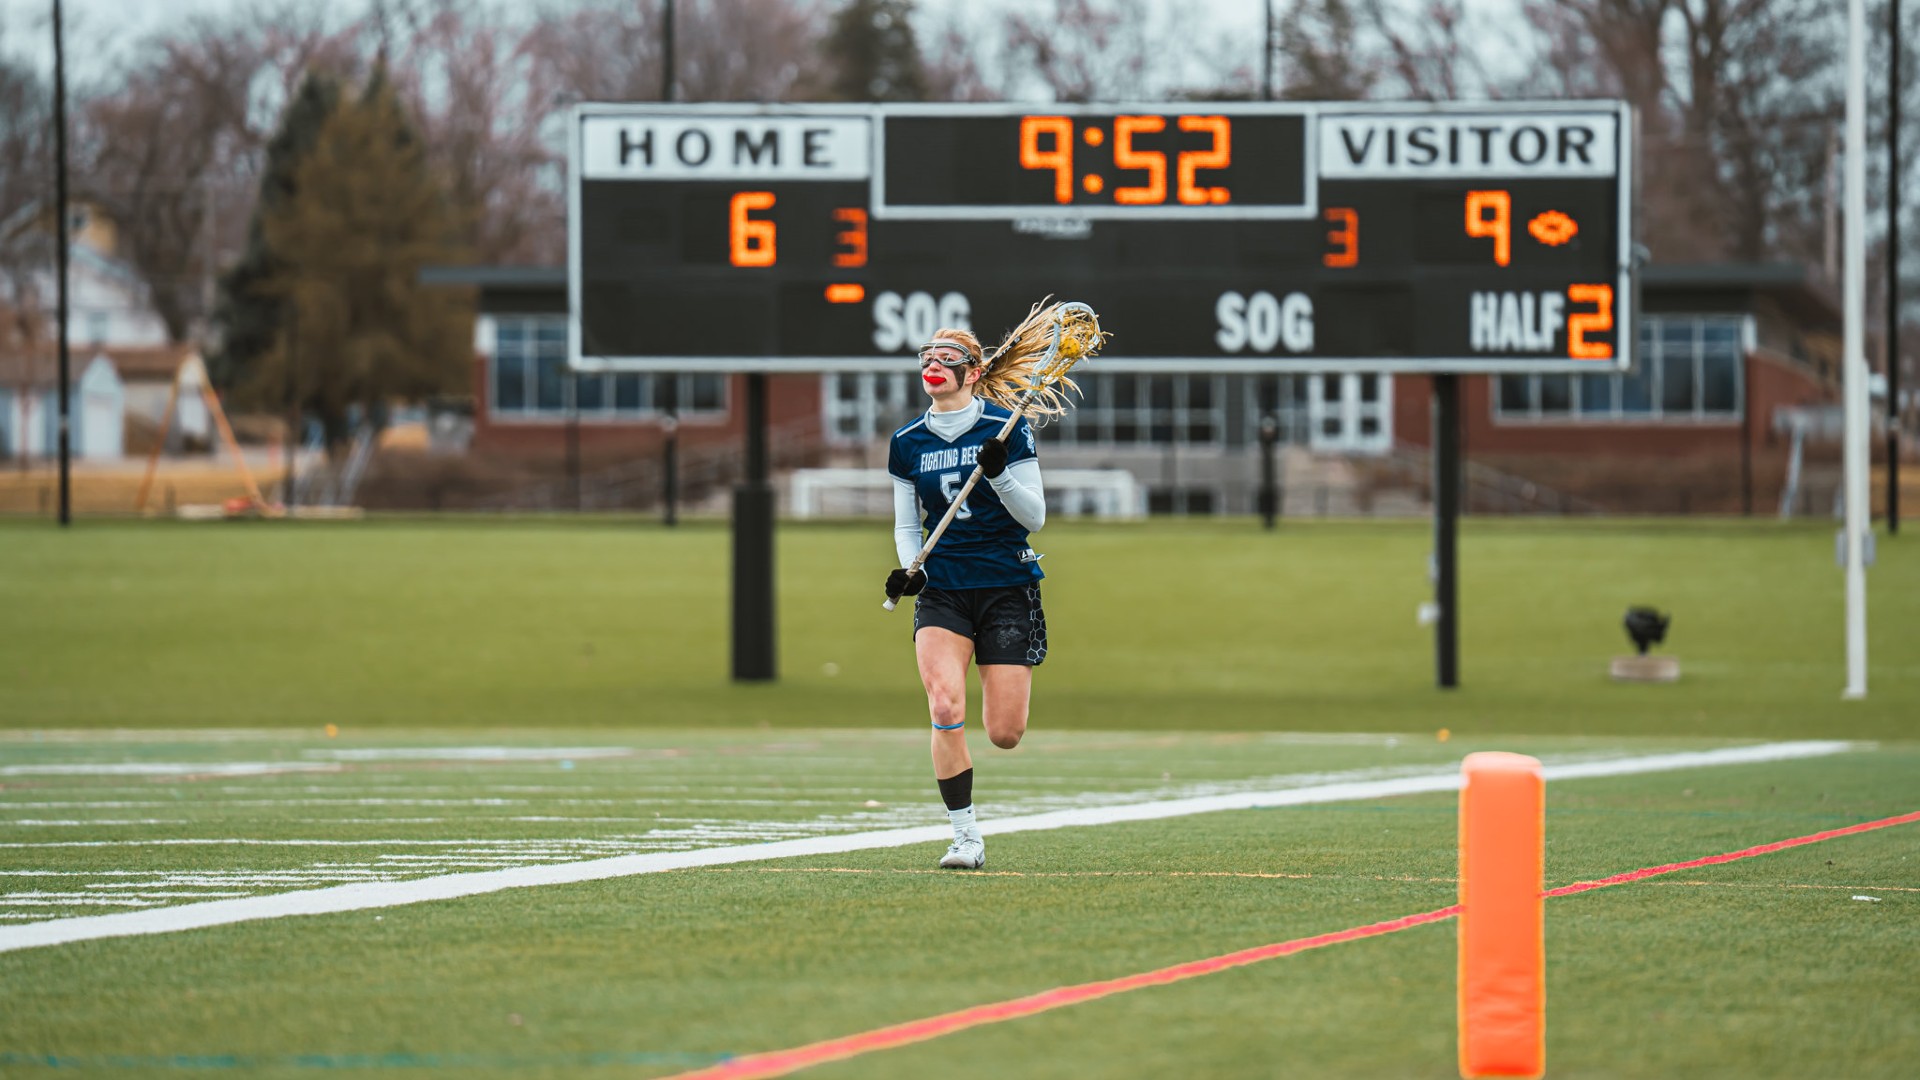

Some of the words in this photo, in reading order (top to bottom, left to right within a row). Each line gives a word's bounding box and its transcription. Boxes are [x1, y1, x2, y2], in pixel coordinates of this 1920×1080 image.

[618, 129, 834, 167] HOME
[1020, 115, 1231, 205] 9:52
[1340, 126, 1595, 165] VISITOR
[730, 191, 777, 268] 6
[833, 208, 868, 268] 3
[1323, 208, 1359, 268] 3
[1465, 190, 1511, 267] 9
[873, 291, 972, 353] SOG
[1216, 291, 1315, 353] SOG
[1470, 292, 1564, 353] HALF
[1568, 284, 1613, 360] 2
[920, 448, 958, 473] FIGHTING
[960, 445, 984, 466] BEE
[940, 471, 972, 519] 5
